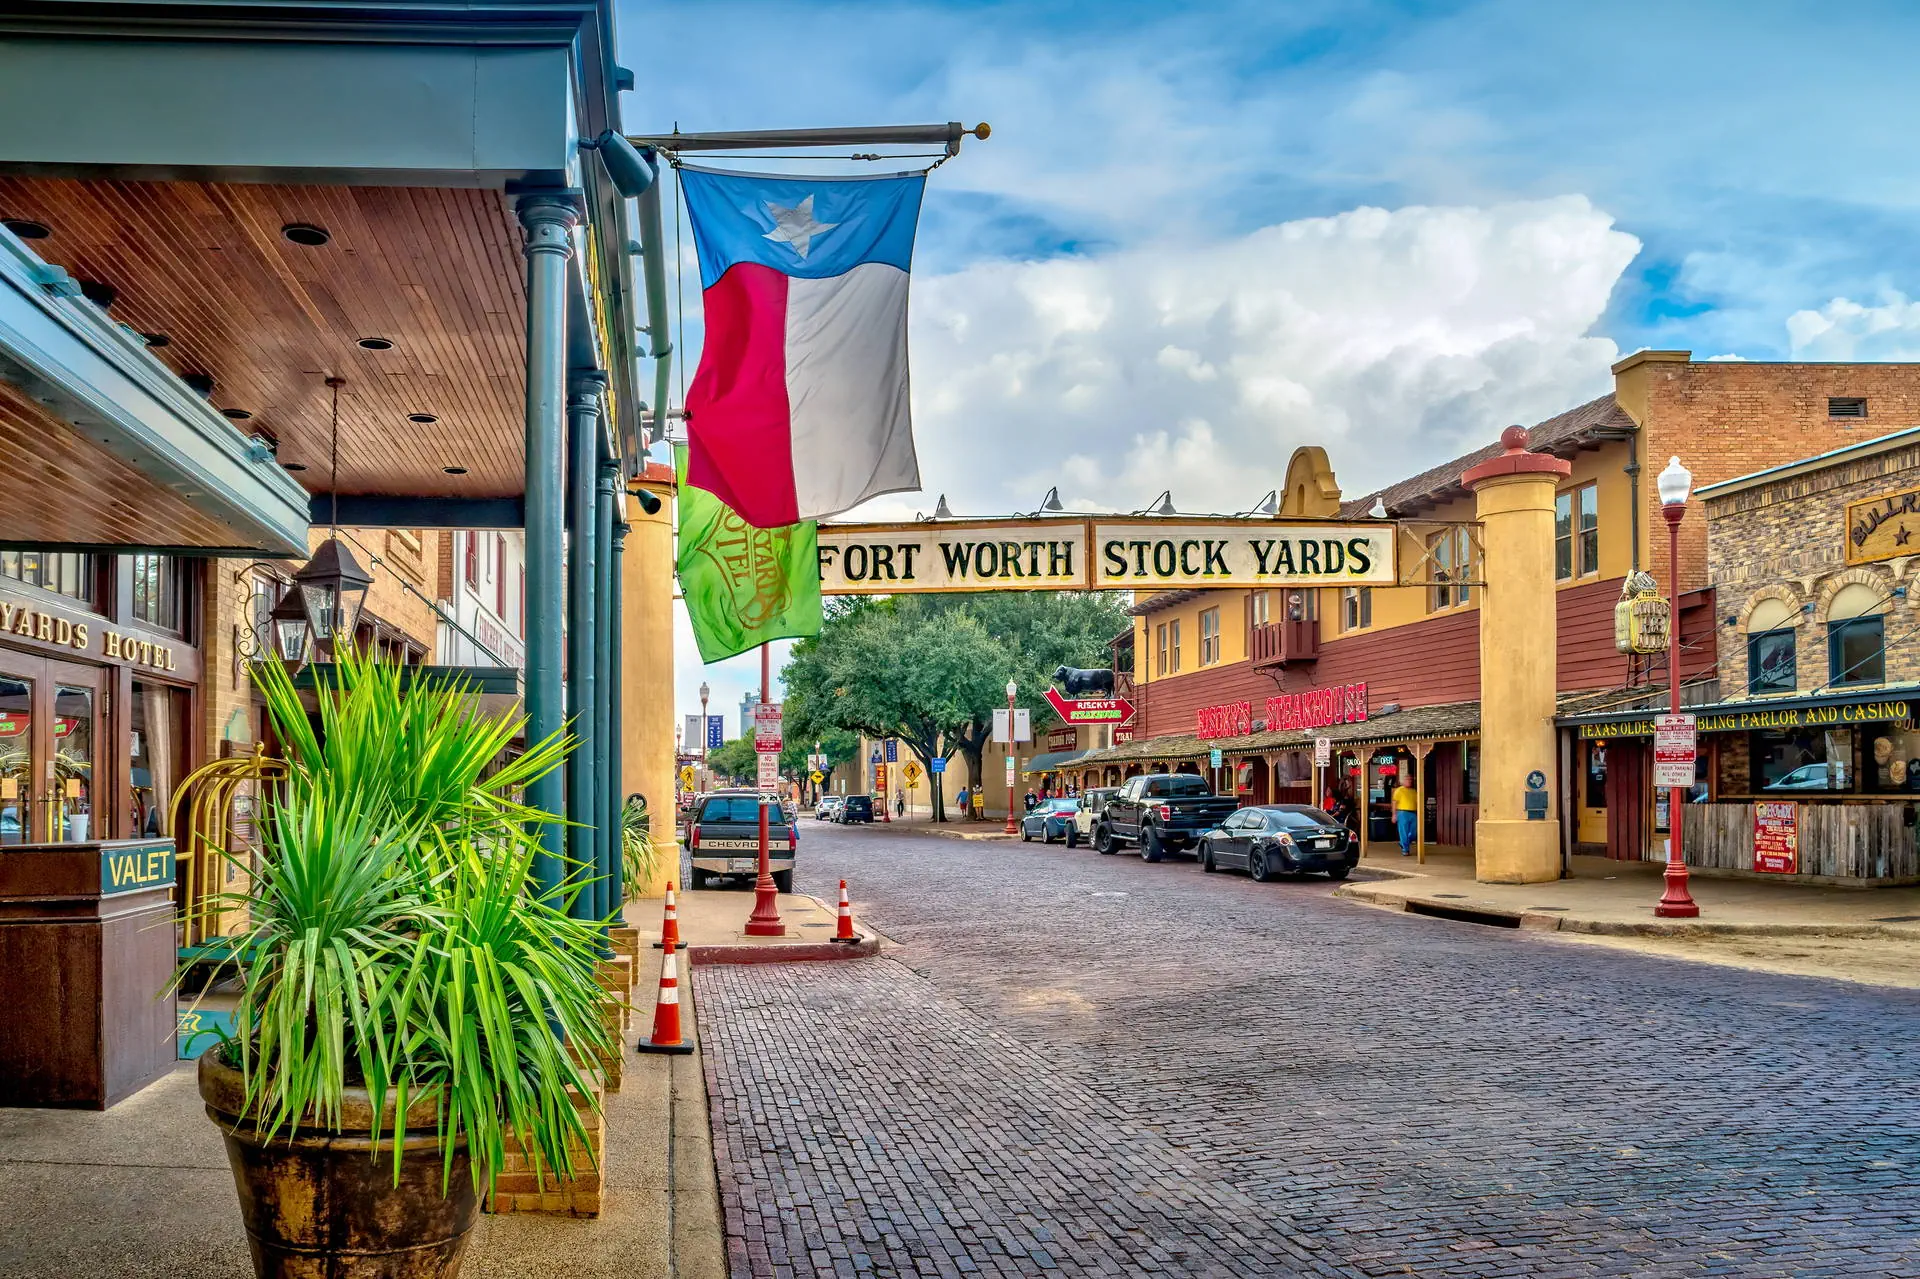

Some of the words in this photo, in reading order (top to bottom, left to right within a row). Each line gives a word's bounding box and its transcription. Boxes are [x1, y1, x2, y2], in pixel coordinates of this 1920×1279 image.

[818, 544, 920, 581] FORT
[939, 541, 1074, 578] WORTH
[1105, 540, 1231, 577] STOCK
[1249, 538, 1371, 576] YARDS
[104, 631, 176, 671] HOTEL
[1077, 701, 1116, 709] RISCKY'S
[1266, 682, 1367, 732] STEAKHOUSE
[1580, 724, 1618, 738] TEXAS
[1620, 720, 1656, 736] OLDES
[1697, 714, 1736, 730] BLING
[1740, 710, 1799, 728] PARLOR
[1805, 706, 1838, 723] AND
[1843, 701, 1907, 720] CASINO
[109, 850, 171, 887] VALET
